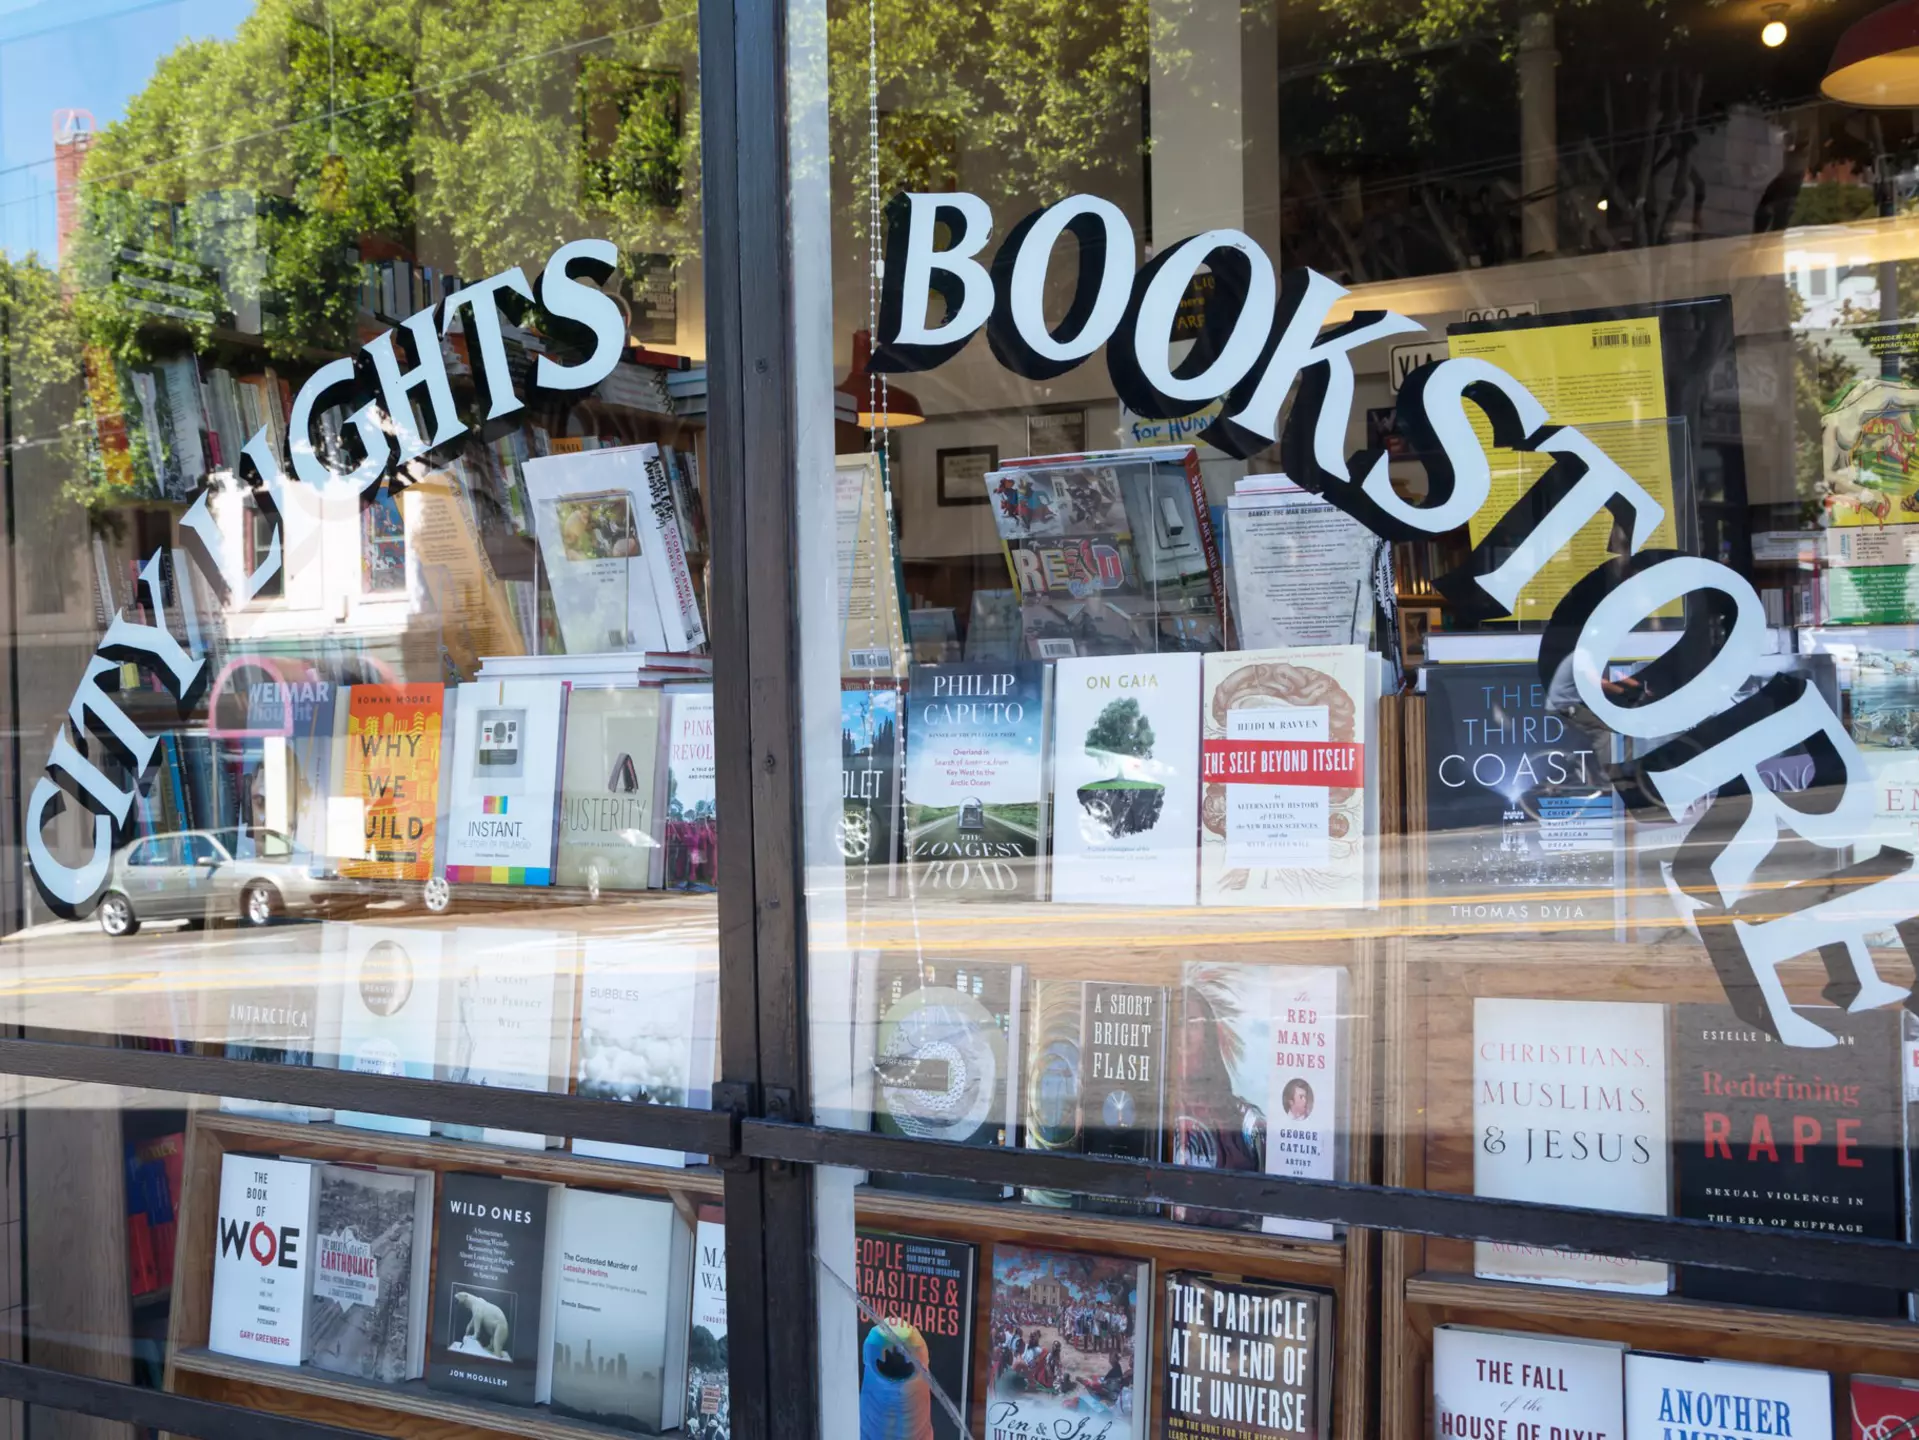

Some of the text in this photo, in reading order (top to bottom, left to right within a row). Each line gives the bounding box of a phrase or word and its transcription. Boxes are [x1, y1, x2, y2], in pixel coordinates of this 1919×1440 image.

[663, 533, 688, 617] GEORGE ORWELL
[669, 527, 695, 610] GEORGE ORWELL
[27, 191, 1919, 1049] CITY LIGHTS BOOKSTORE
[249, 682, 330, 704] WEIMAR
[932, 673, 1016, 697] PHILIP
[1086, 673, 1159, 690] ON GAIA
[358, 695, 432, 705] ROWAN MOORE
[1482, 683, 1543, 710] THE
[923, 702, 1024, 726] CAPUTO
[683, 719, 713, 738] PINK
[1237, 721, 1266, 732] HEIDI
[1462, 715, 1564, 746] THIRD
[361, 734, 422, 758] WHY
[952, 748, 981, 757] Overland
[934, 758, 956, 766] Search
[946, 768, 959, 778] Key
[959, 768, 975, 777] West
[984, 768, 996, 777] the
[1204, 748, 1356, 775] THE SELF BEYOND ITSELF
[1438, 750, 1593, 788] COAST
[367, 775, 407, 799] WE
[950, 778, 991, 787] Arctic Ocean
[563, 797, 647, 832] AUSTERITY
[1287, 802, 1320, 810] HISTORY
[468, 820, 523, 838] INSTANT
[959, 833, 982, 842] THE
[914, 841, 1026, 857] LONGEST
[919, 860, 1019, 891] ROAD
[1450, 904, 1584, 920] THOMAS DYJA
[589, 987, 640, 1002] BUBBLES
[1094, 993, 1152, 1017] A SHORT
[229, 1003, 309, 1029] ANTARCTICA
[1287, 1008, 1318, 1025] RED
[1093, 1021, 1152, 1048] BRIGHT
[1277, 1029, 1326, 1048] MAN'S
[1703, 1030, 1778, 1043] ESTELLE B.
[1092, 1051, 1151, 1082] FLASH
[1276, 1051, 1327, 1070] BONES
[1703, 1070, 1861, 1108] Redefining
[1279, 1128, 1318, 1142] GEORGE
[1483, 1125, 1651, 1166] & JESUS
[1703, 1111, 1864, 1168] RAPE
[1279, 1142, 1321, 1157] CATLIN,
[1285, 1157, 1312, 1168] ARTIST
[254, 1171, 268, 1185] THE
[246, 1187, 268, 1202] BOOK
[1705, 1187, 1864, 1206] SEXUAL VIOLENCE IN
[256, 1205, 267, 1218] OF
[450, 1200, 533, 1224] WILD ONES
[1708, 1214, 1864, 1234] THE ERA OF SUFFRAGE
[220, 1217, 300, 1269] WOE
[906, 1244, 931, 1255] LEARNING
[320, 1250, 375, 1279] EARTHQUAKE
[563, 1252, 638, 1272] The Contested Murder of
[944, 1278, 959, 1308] &
[1173, 1284, 1308, 1342] THE PARTICLE
[239, 1329, 291, 1347] GARY GREENBERG
[1170, 1328, 1308, 1387] AT THE END OF
[449, 1369, 508, 1387] JON MOOALLEM
[1476, 1358, 1569, 1392] THE FALL
[1169, 1371, 1307, 1434] THE UNIVERSE
[1500, 1396, 1544, 1414] of the
[1657, 1387, 1793, 1438] ANOTHER
[988, 1401, 1033, 1432] Pen
[1035, 1422, 1048, 1436] &
[1053, 1416, 1113, 1440] Ink
[1168, 1416, 1252, 1440] HOW THE HUNT FOR THE
[1441, 1411, 1508, 1440] HOUSE
[1516, 1421, 1541, 1440] OF
